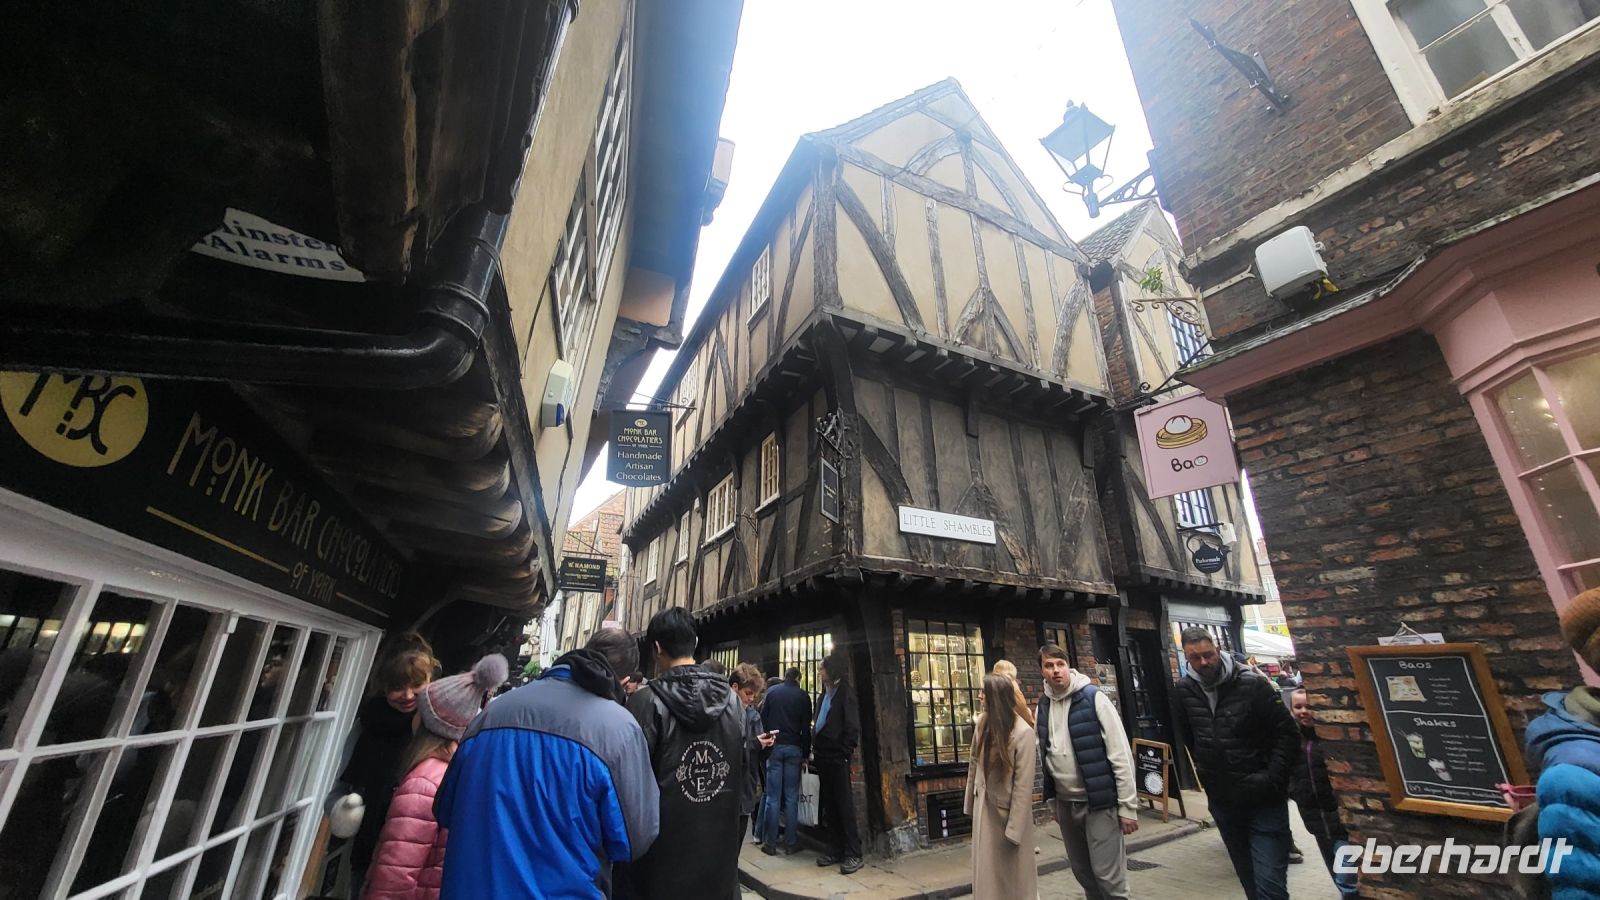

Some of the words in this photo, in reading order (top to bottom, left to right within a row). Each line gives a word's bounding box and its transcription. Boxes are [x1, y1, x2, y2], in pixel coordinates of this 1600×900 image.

[211, 234, 346, 272] Alarms
[623, 428, 643, 436] MONK
[644, 429, 658, 437] BAR
[617, 435, 663, 445] CHOCOLATIERS
[617, 451, 663, 461] Handmade
[624, 462, 654, 470] Artisan
[166, 410, 274, 522] MONK
[267, 480, 321, 551] BAR
[615, 471, 662, 481] Chocolates
[903, 513, 937, 529] LITTLE
[943, 519, 993, 537] SHAMBLES
[290, 561, 309, 590] OF
[309, 568, 338, 603] YORK
[1398, 660, 1432, 670] Baos
[1413, 717, 1457, 728] Shakes
[695, 749, 709, 765] M
[696, 776, 706, 792] E
